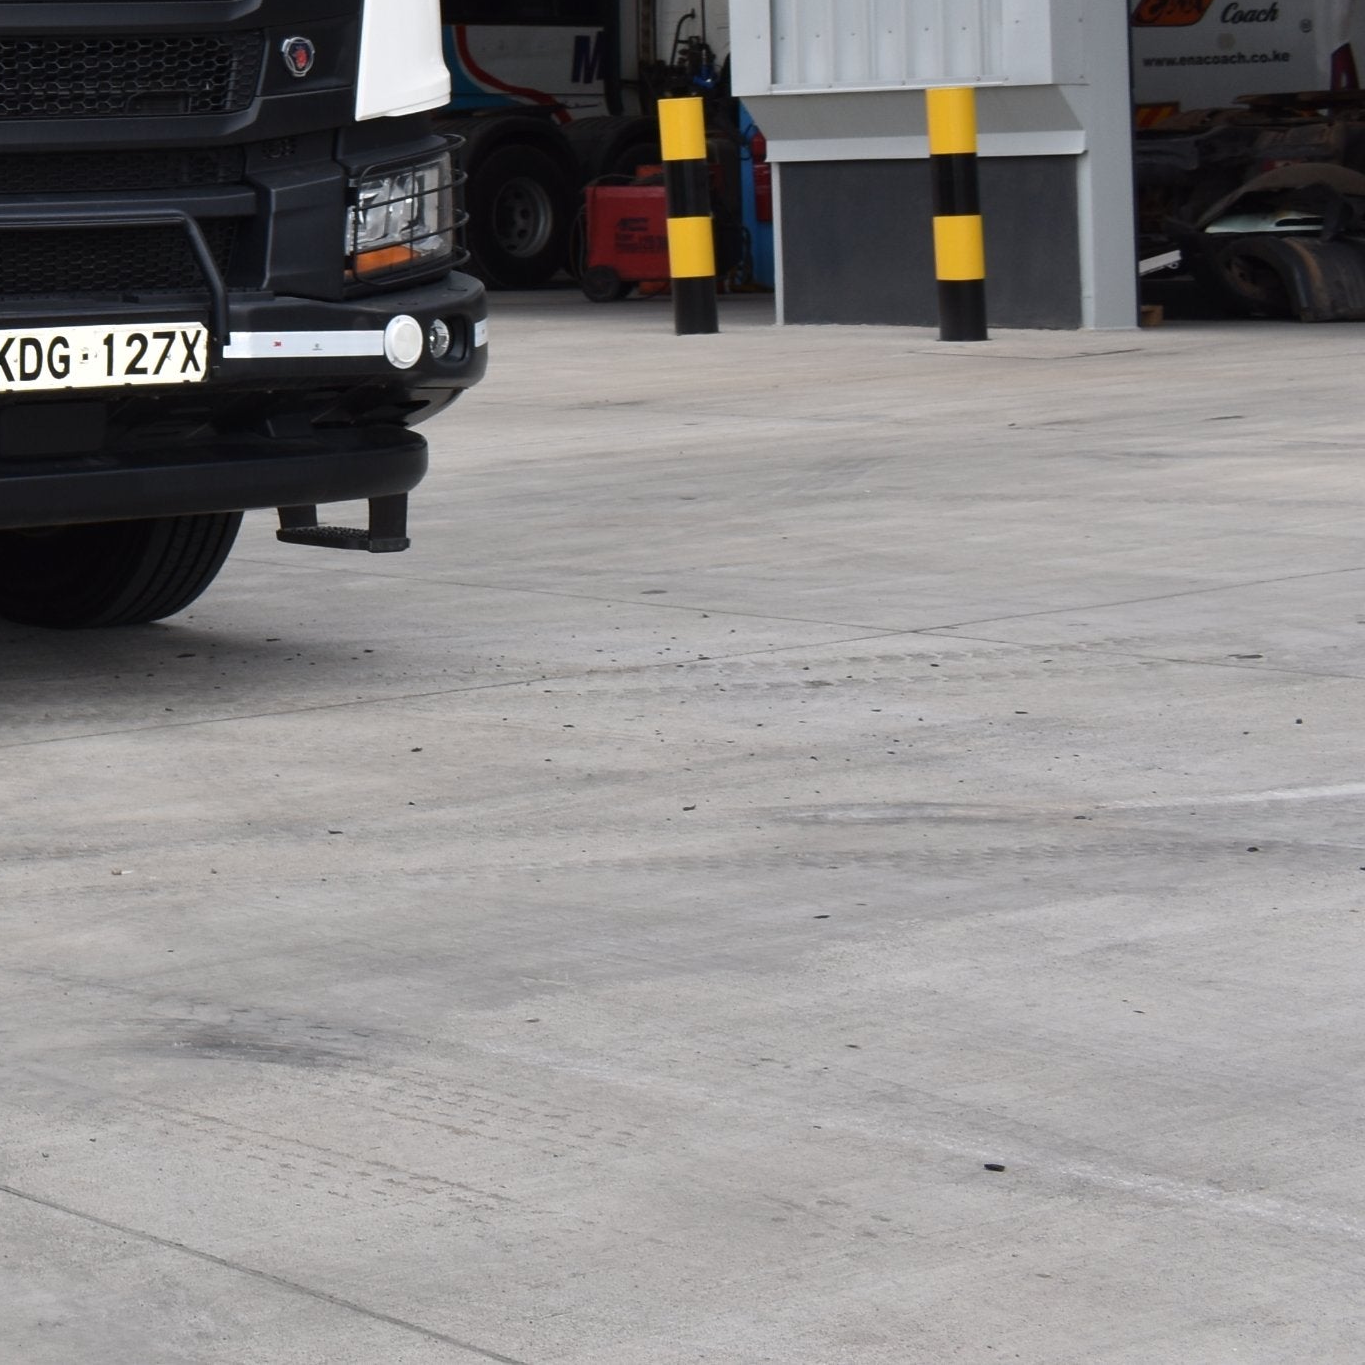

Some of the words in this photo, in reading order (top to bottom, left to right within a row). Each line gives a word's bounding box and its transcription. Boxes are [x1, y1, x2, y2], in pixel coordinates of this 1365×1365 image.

[1221, 2, 1279, 24] Coach
[1142, 50, 1290, 67] www.enacoach.co.ke
[103, 330, 202, 376] 127X
